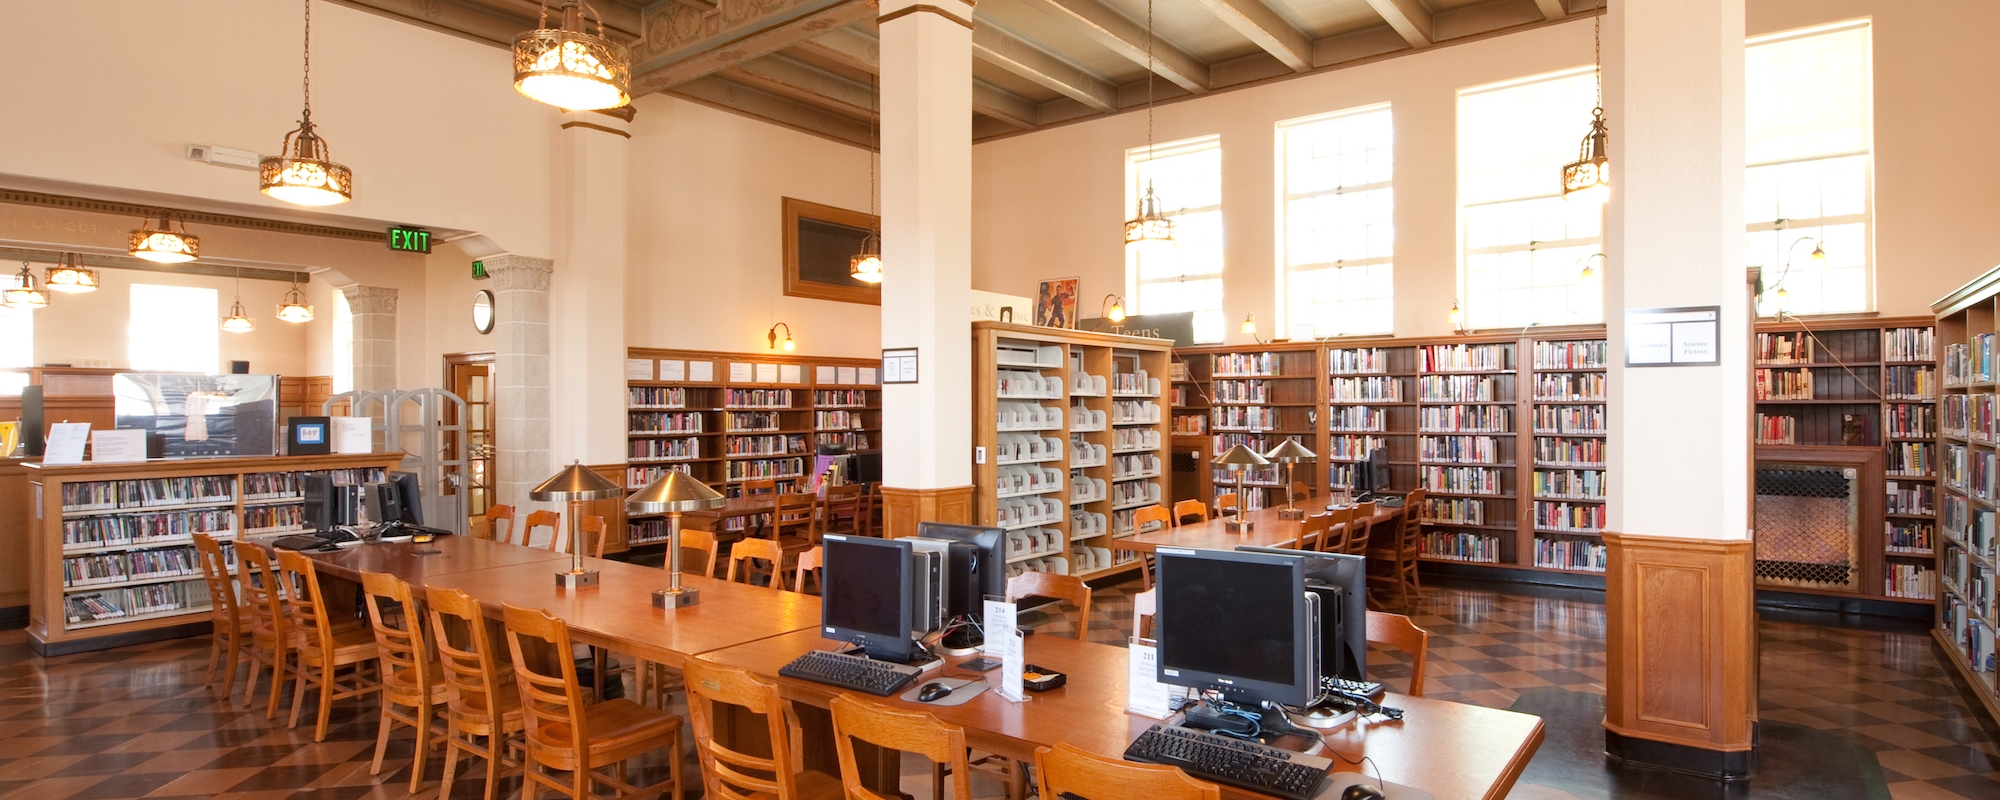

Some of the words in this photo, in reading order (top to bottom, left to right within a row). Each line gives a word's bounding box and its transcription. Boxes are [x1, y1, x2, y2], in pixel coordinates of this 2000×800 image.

[391, 229, 429, 251] EXIT
[1111, 324, 1160, 339] Teens
[995, 606, 1005, 614] 214
[1143, 652, 1154, 661] 211
